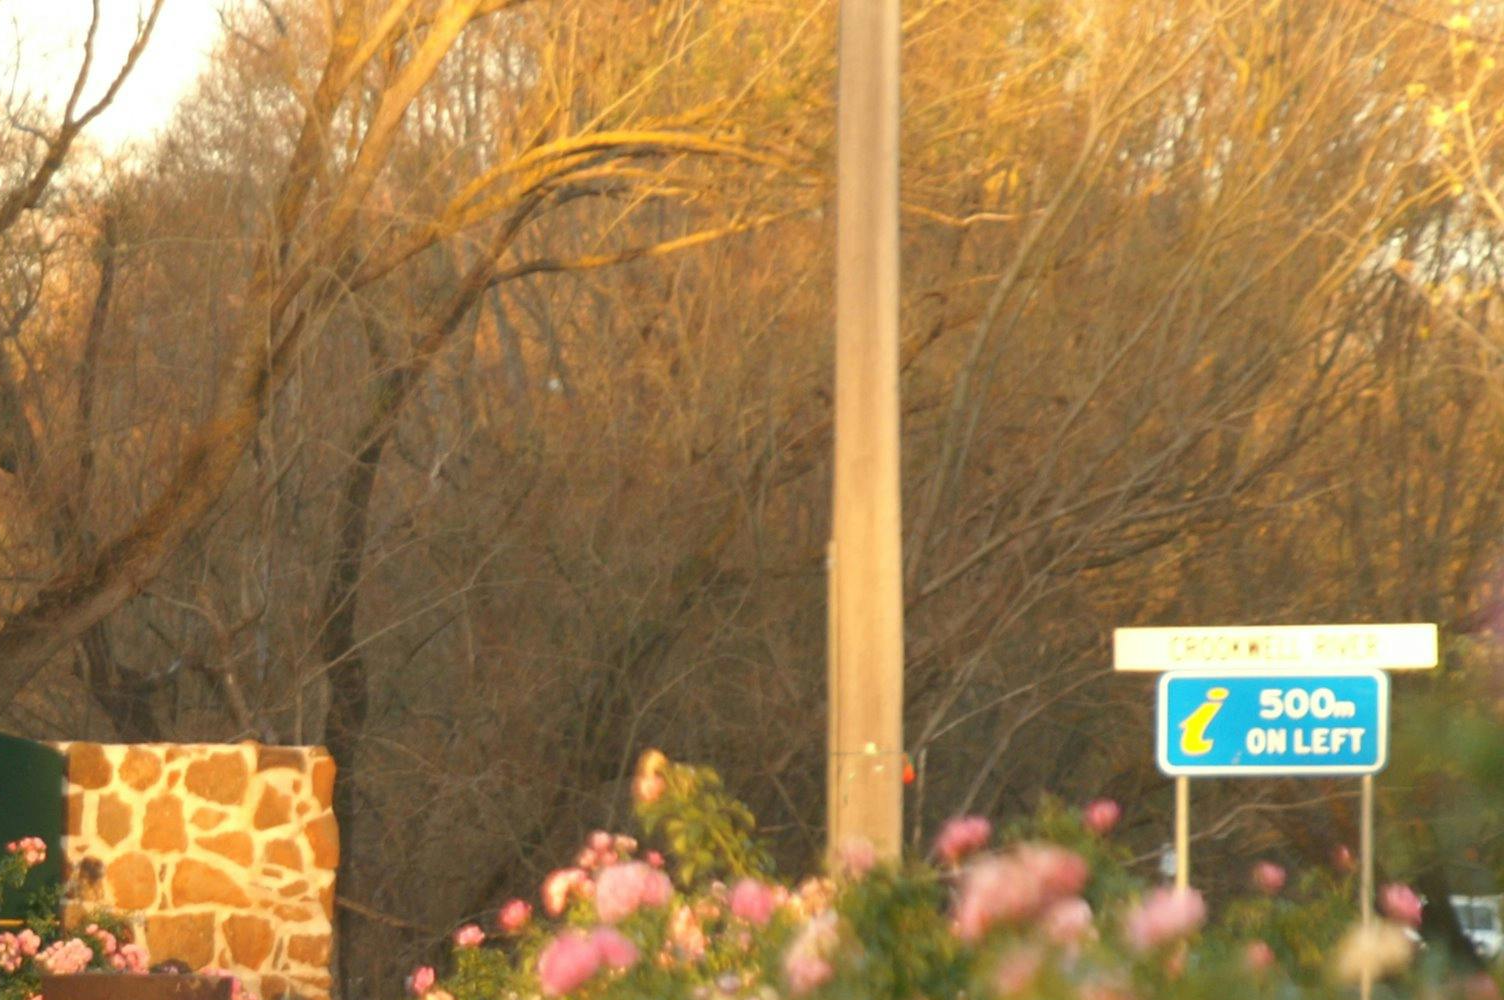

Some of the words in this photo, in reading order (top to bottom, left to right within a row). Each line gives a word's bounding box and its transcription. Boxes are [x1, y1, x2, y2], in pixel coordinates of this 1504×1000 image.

[1259, 687, 1356, 719] 500m
[1246, 727, 1287, 755] ON
[1293, 728, 1365, 755] LEFT
